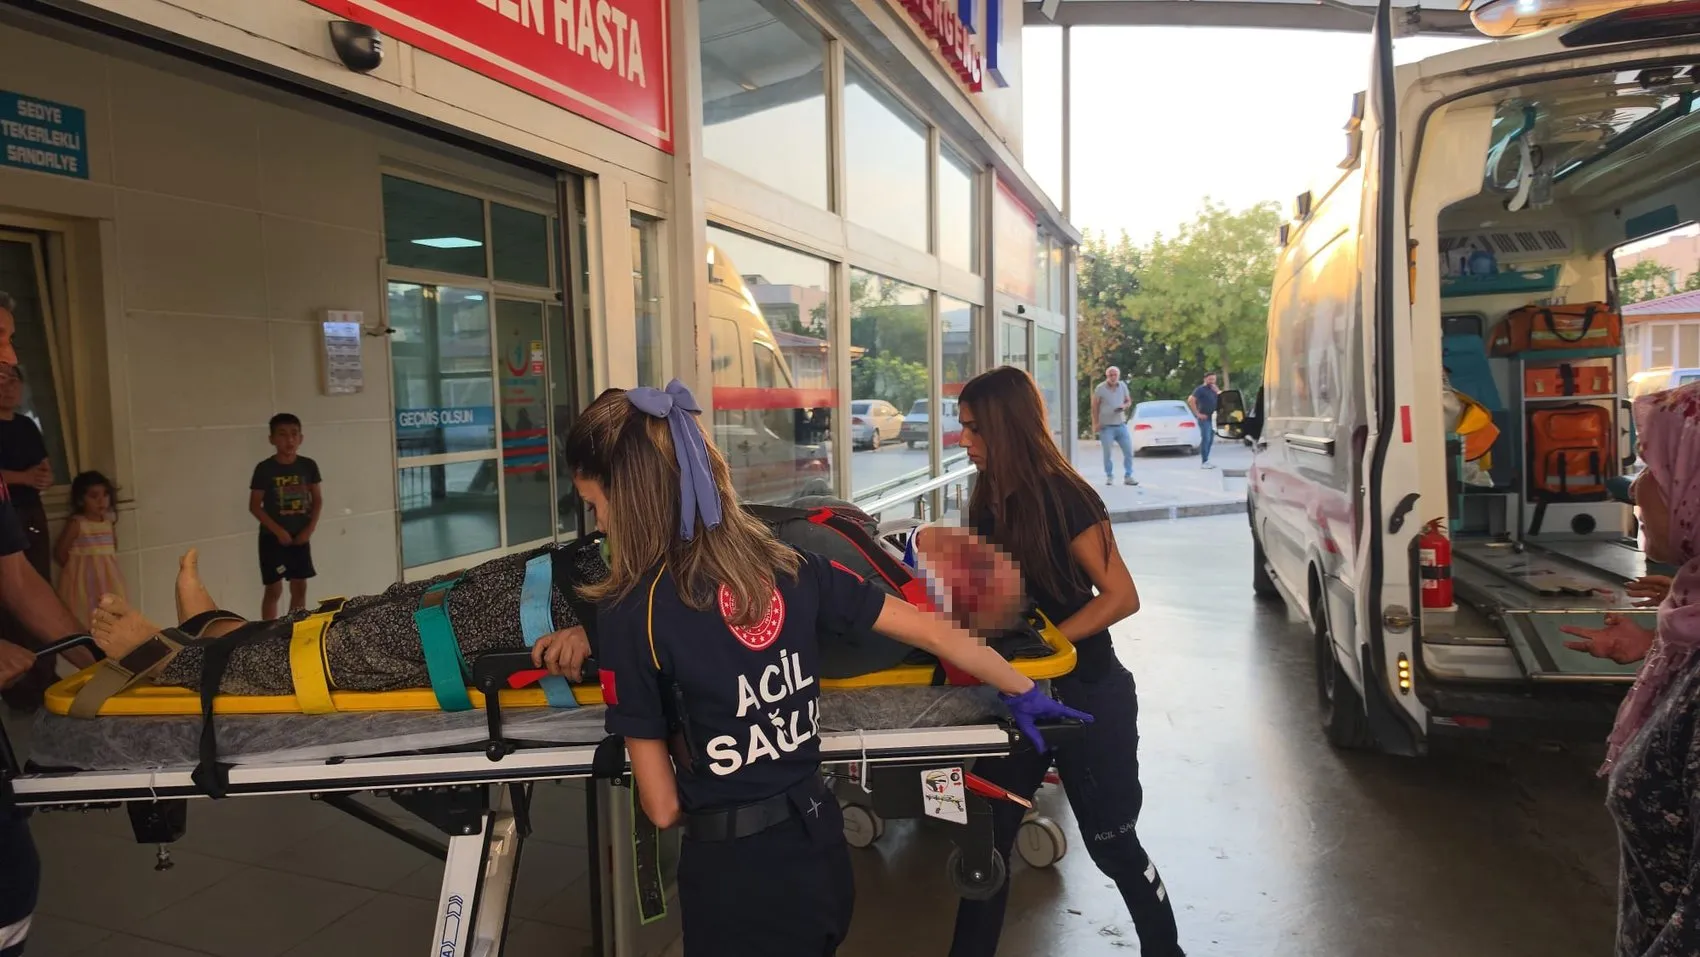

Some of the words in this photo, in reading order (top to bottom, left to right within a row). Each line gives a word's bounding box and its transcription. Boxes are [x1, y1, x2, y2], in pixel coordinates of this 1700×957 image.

[553, 0, 646, 88] HASTA
[17, 100, 62, 124] SEDYE
[1, 119, 80, 151] TEKERLEKLİ
[7, 144, 78, 172] SANDALYE
[399, 408, 439, 428] GEÇMİŞ
[440, 409, 473, 425] OLSUN
[736, 649, 814, 718] ACİL
